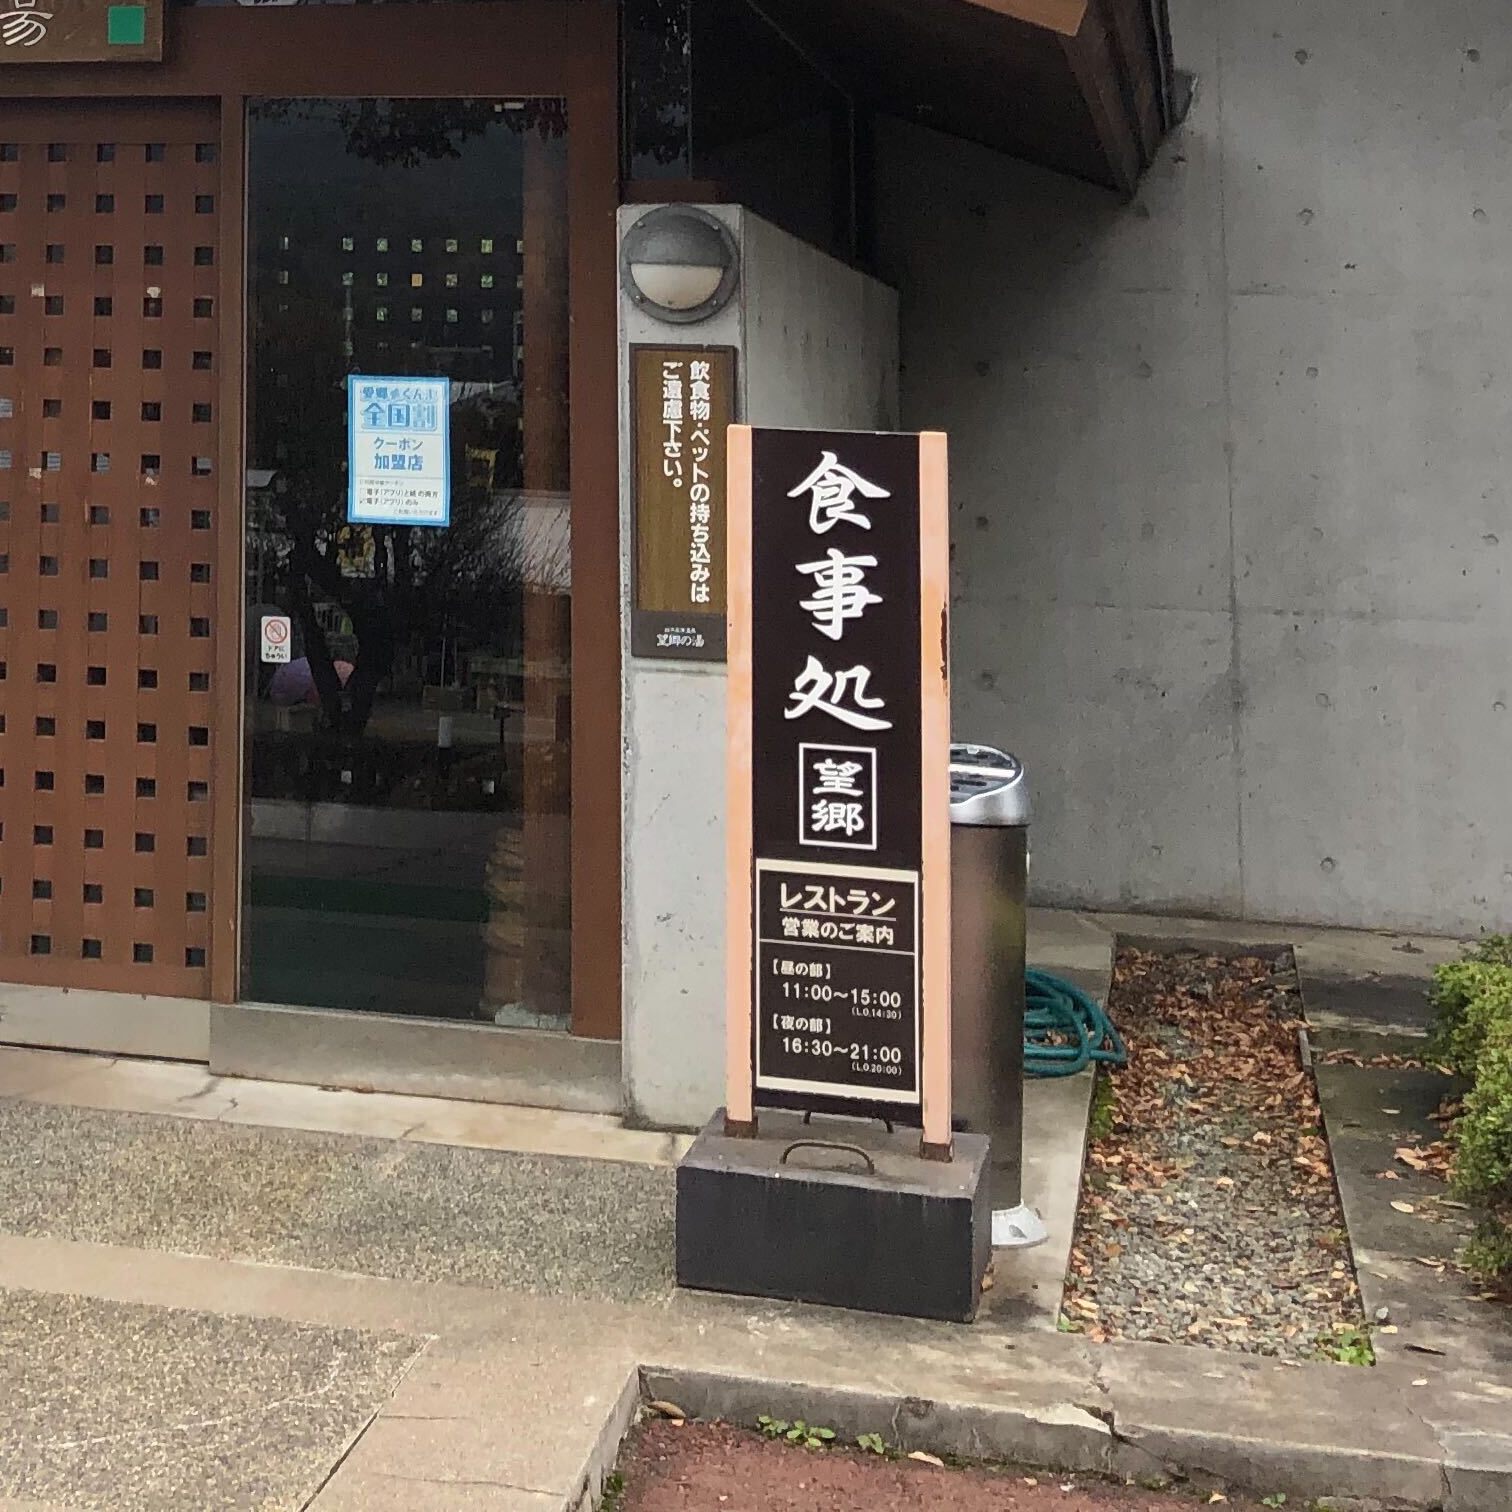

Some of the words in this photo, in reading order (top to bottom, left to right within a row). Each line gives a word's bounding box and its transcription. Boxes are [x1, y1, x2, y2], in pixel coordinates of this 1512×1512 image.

[362, 402, 437, 428] 全国割
[662, 360, 683, 488] ご遠慮下さい。
[373, 436, 424, 450] クーポン
[374, 453, 424, 472] 加盟店
[689, 360, 711, 604] 飲食物・ペットの持ち込みは
[784, 451, 893, 731] 食事処
[811, 758, 864, 837] 望郷
[780, 882, 896, 916] レストラン
[781, 916, 894, 945] 営業のご案内
[773, 958, 831, 980] 【昼の部】
[773, 1013, 831, 1035] 【夜の部】
